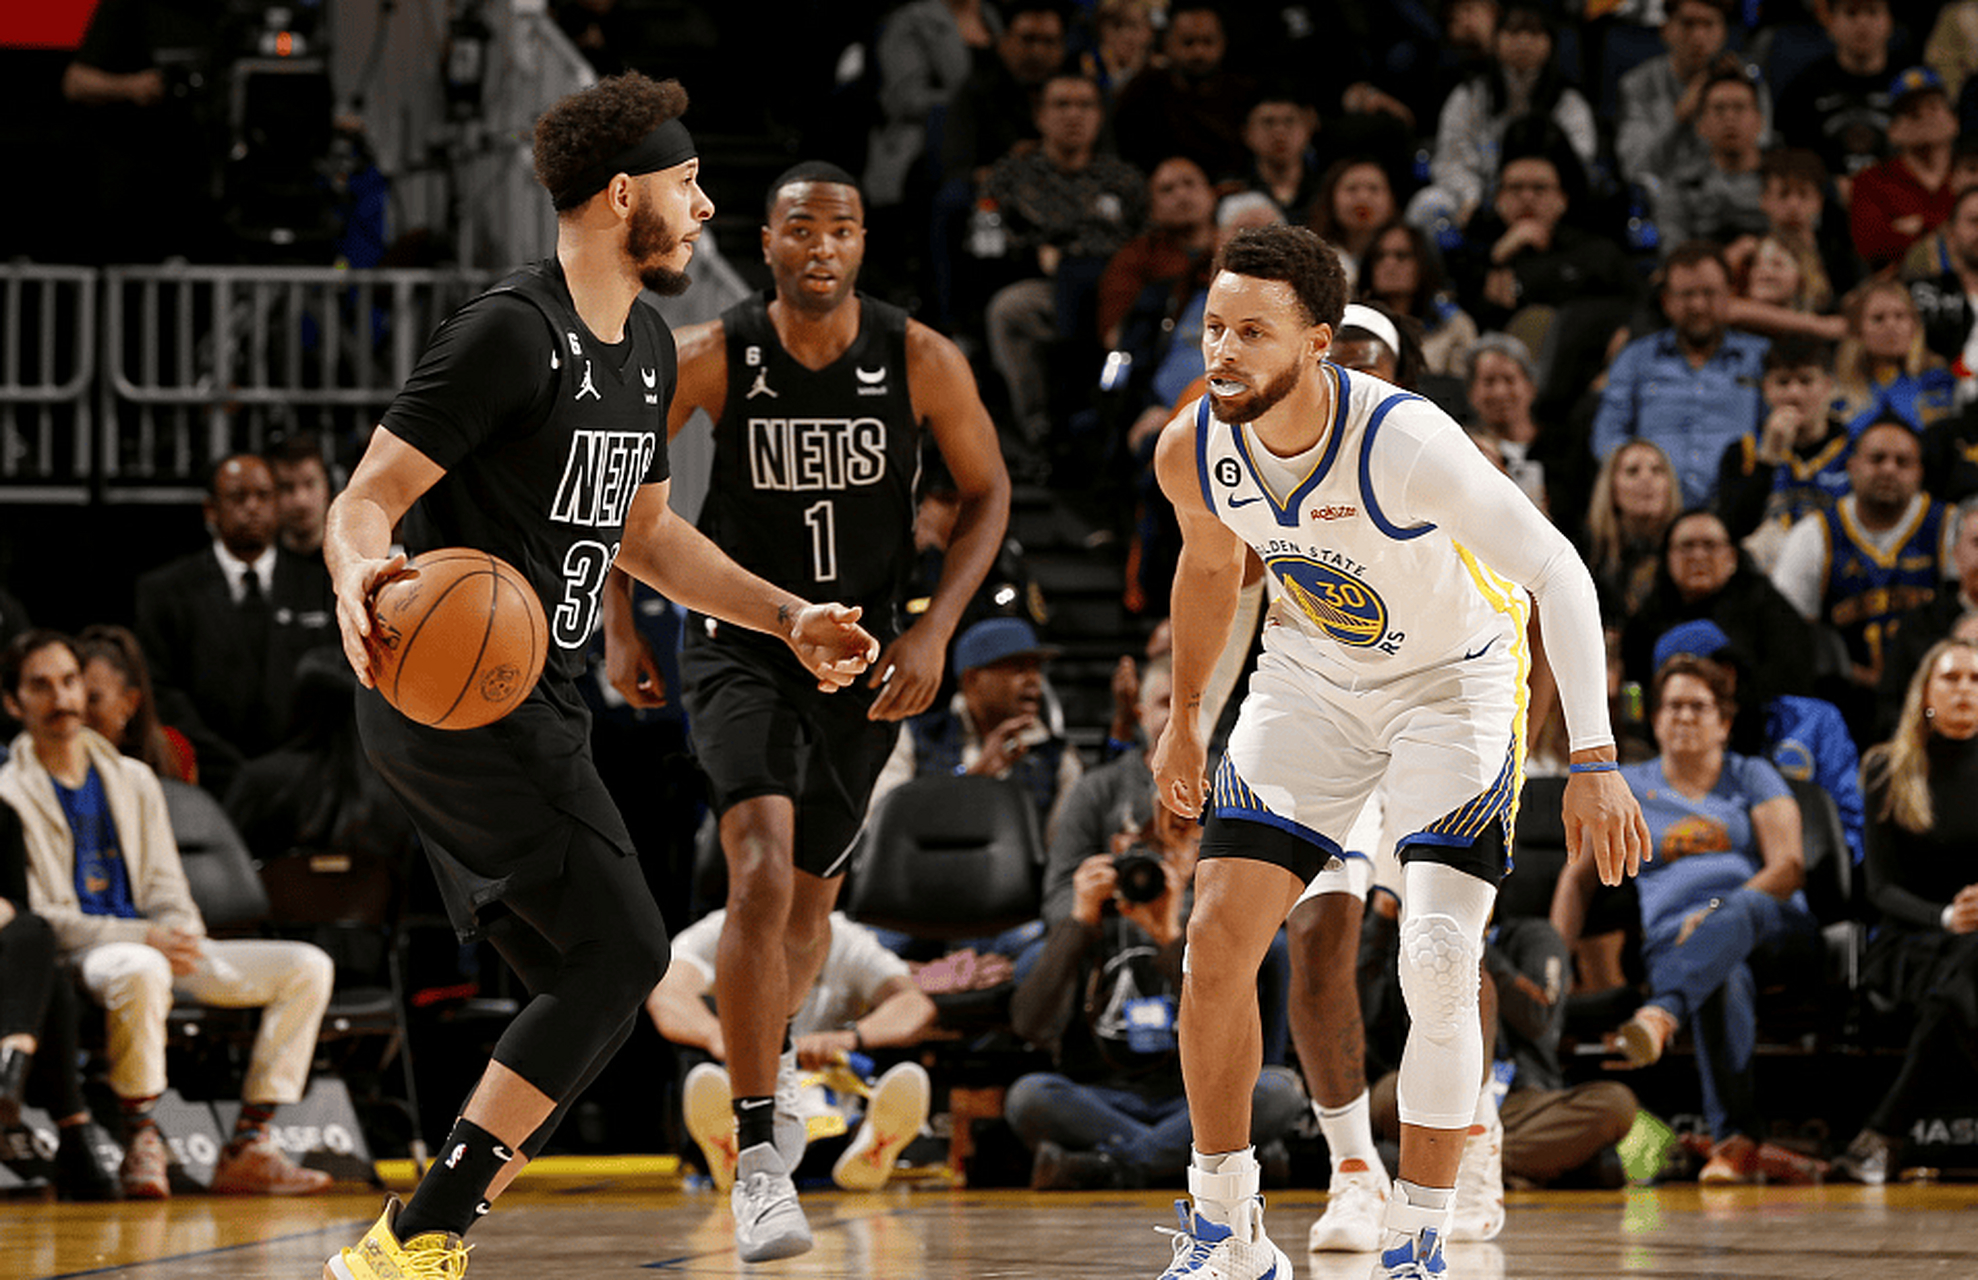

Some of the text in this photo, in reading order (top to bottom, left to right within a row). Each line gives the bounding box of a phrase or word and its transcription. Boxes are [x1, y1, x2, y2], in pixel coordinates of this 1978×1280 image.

[567, 332, 583, 355] 6
[745, 345, 762, 366] 6
[748, 417, 887, 492] NETS
[1220, 461, 1238, 484] 6
[804, 500, 837, 582] 1
[1309, 546, 1367, 577] STATE
[552, 540, 621, 649] 3
[1316, 581, 1366, 608] 30
